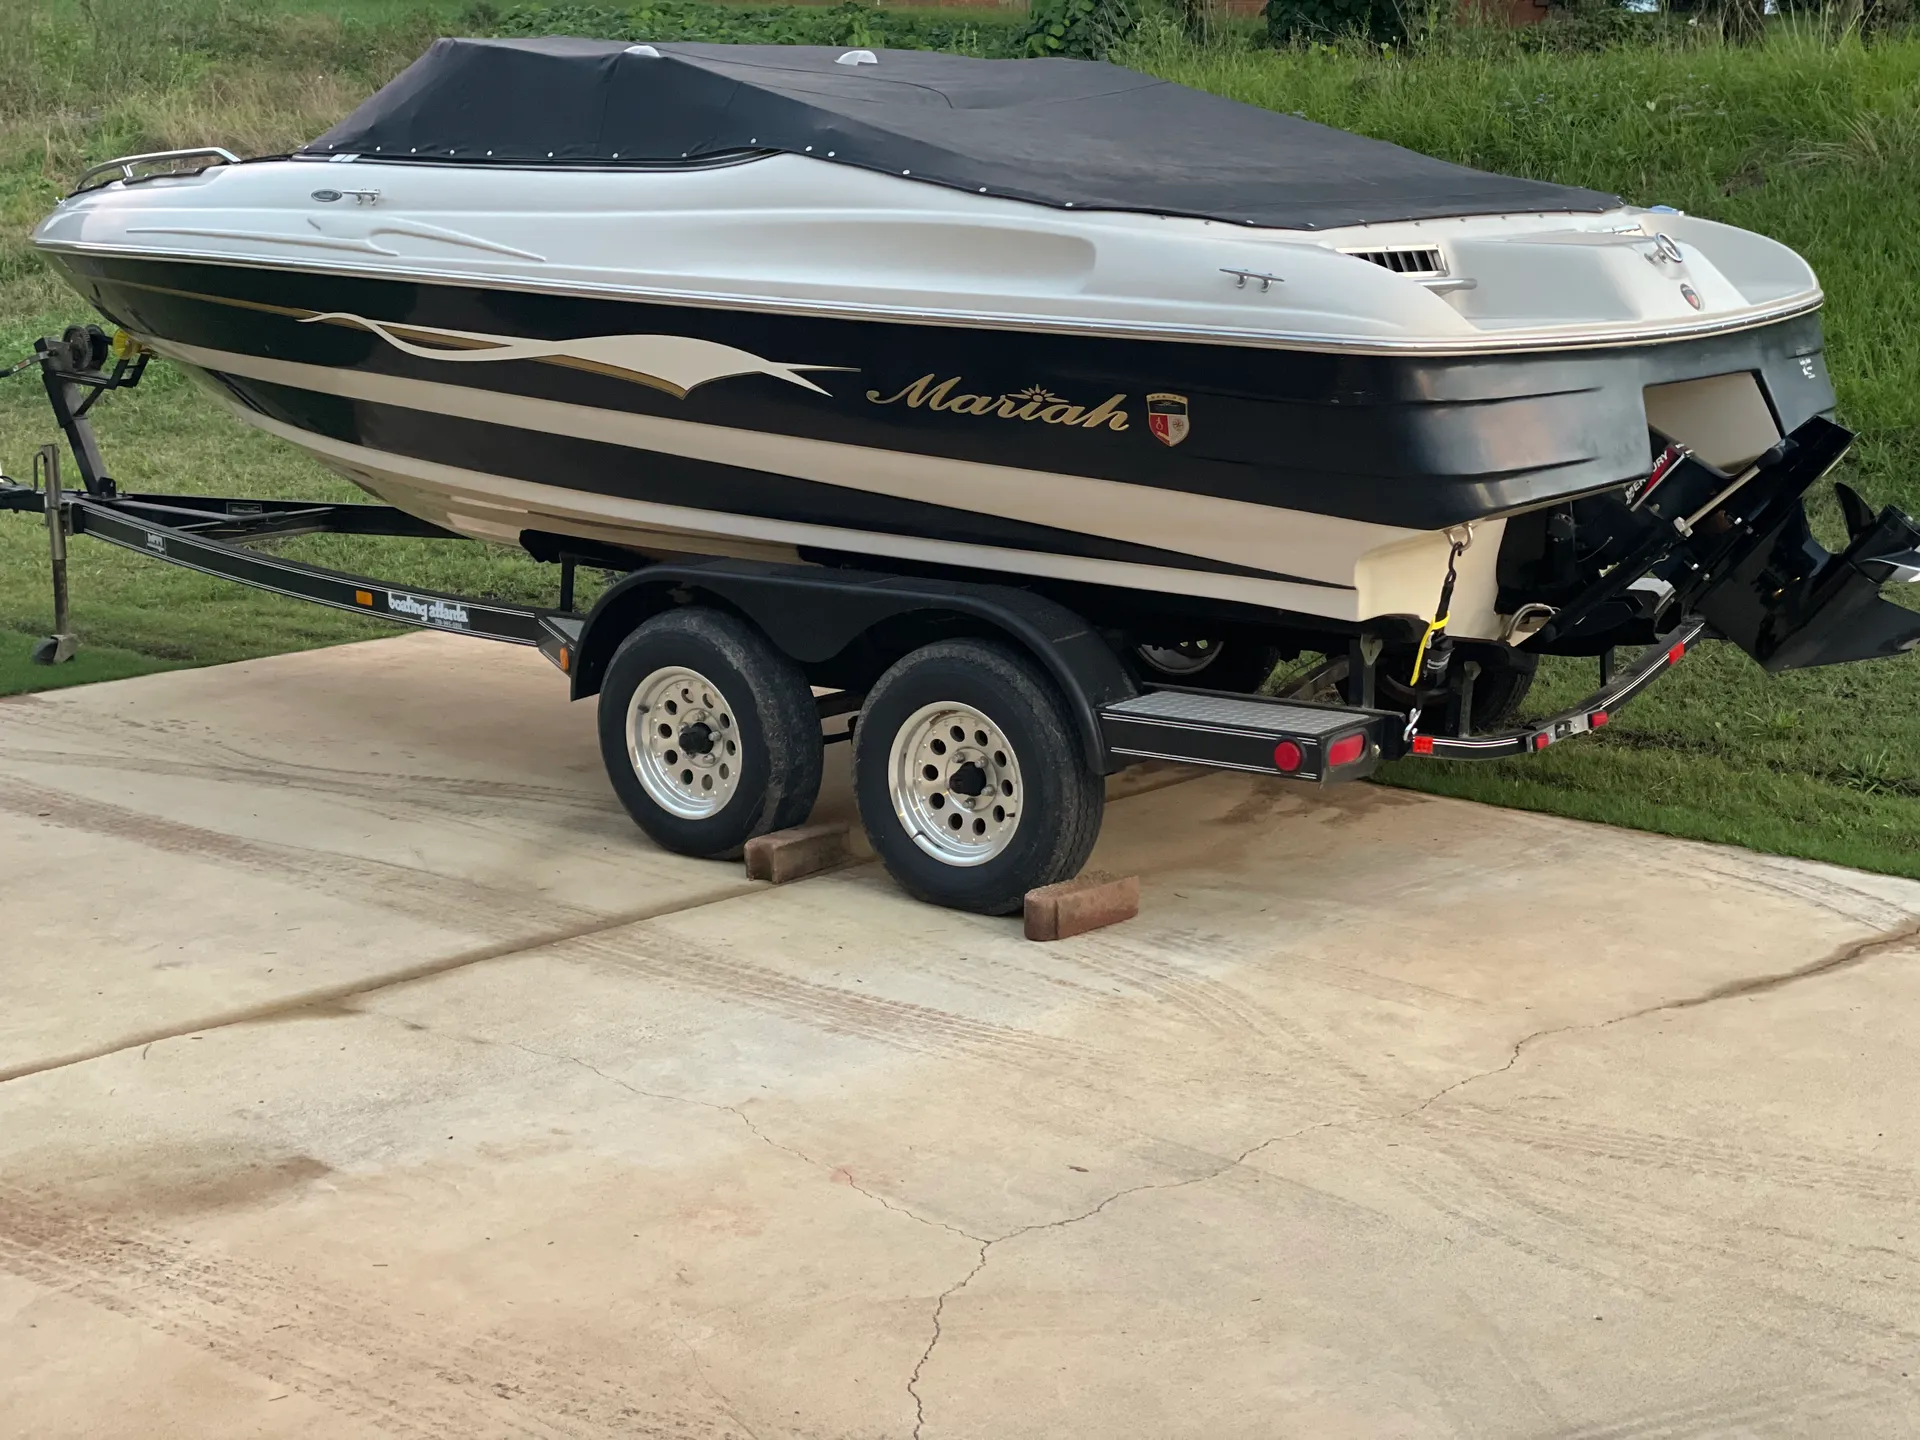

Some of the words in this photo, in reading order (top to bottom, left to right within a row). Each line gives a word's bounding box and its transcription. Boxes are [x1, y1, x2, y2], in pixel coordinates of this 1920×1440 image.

[866, 373, 1130, 431] Mariah
[387, 591, 428, 622] boating
[428, 600, 469, 622] atlanta
